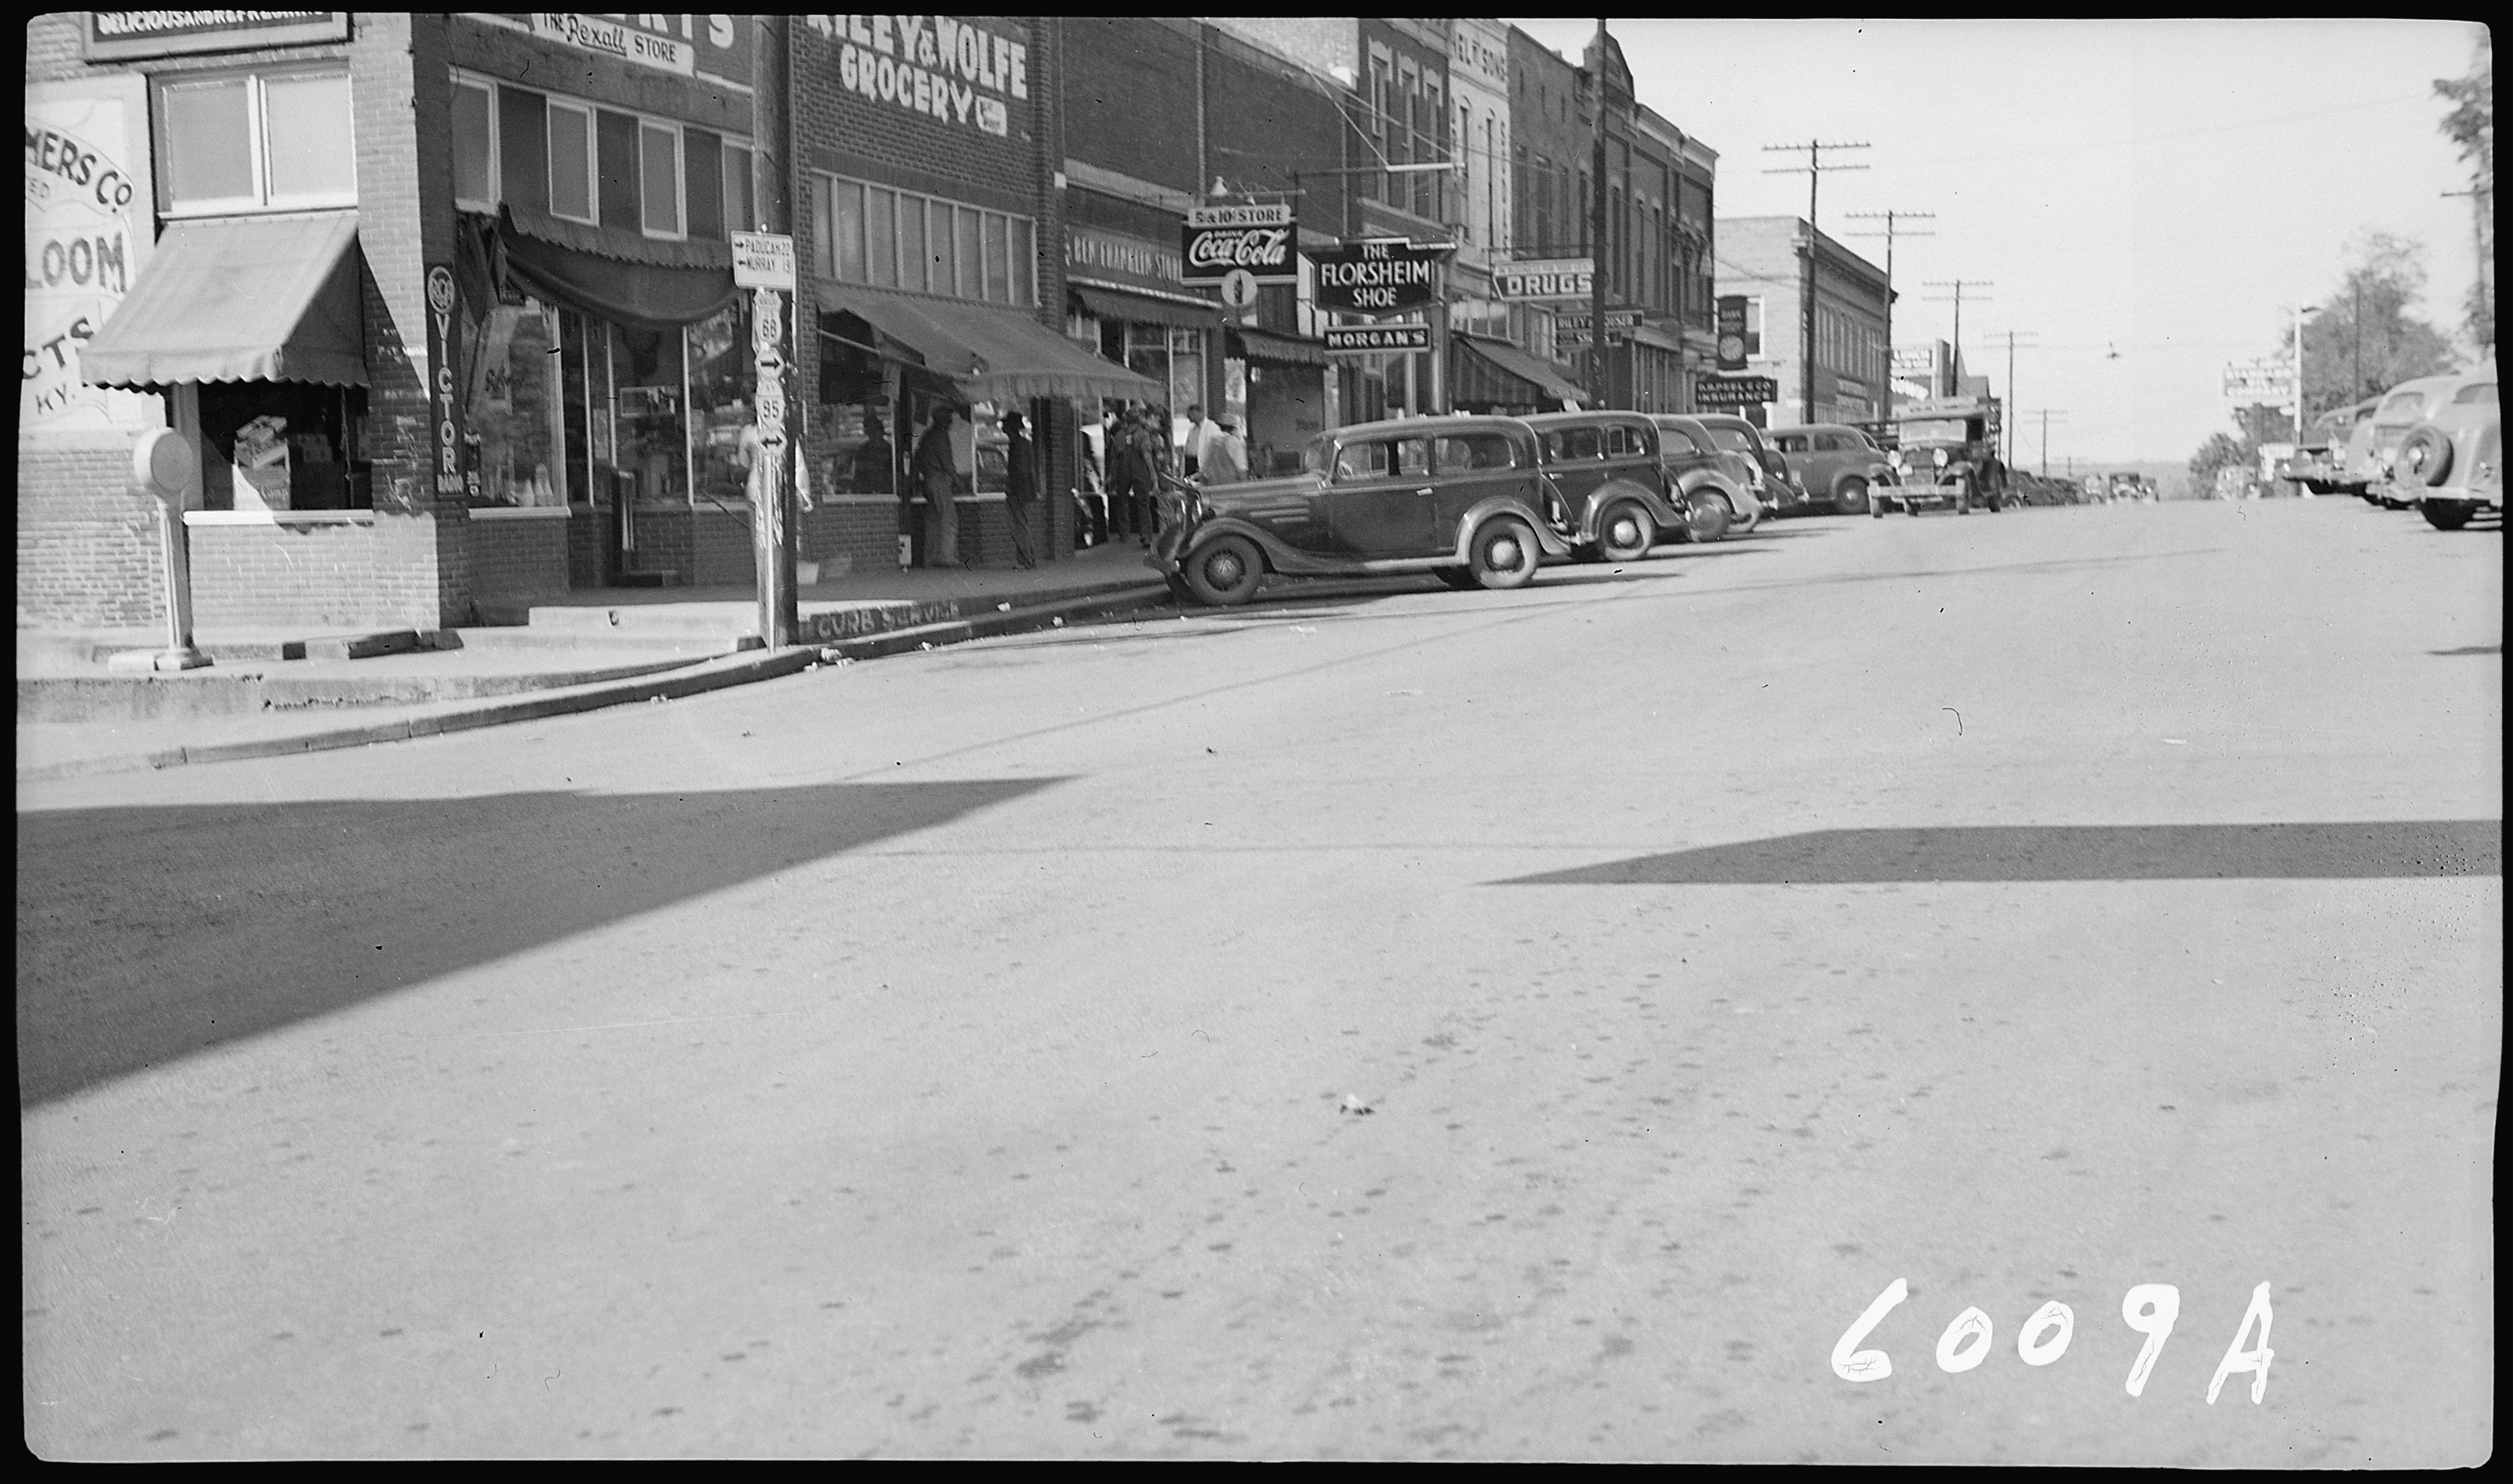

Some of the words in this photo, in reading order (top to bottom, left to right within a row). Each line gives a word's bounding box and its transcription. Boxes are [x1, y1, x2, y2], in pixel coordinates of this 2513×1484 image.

[566, 15, 627, 56] Rexall
[634, 34, 678, 63] STORE
[935, 15, 1028, 100] WOLFE
[839, 43, 973, 125] GROCERY
[1237, 209, 1283, 222] STORE
[1362, 244, 1390, 260] THE
[1321, 260, 1430, 286] FLORSHEIM
[1508, 274, 1592, 295] DRUGS
[1353, 286, 1396, 307] SHOE
[762, 318, 777, 338] 68
[1327, 330, 1425, 348] MORGAN'S
[435, 312, 457, 474] VICTOR
[763, 399, 779, 419] 95
[818, 608, 875, 639] CURB
